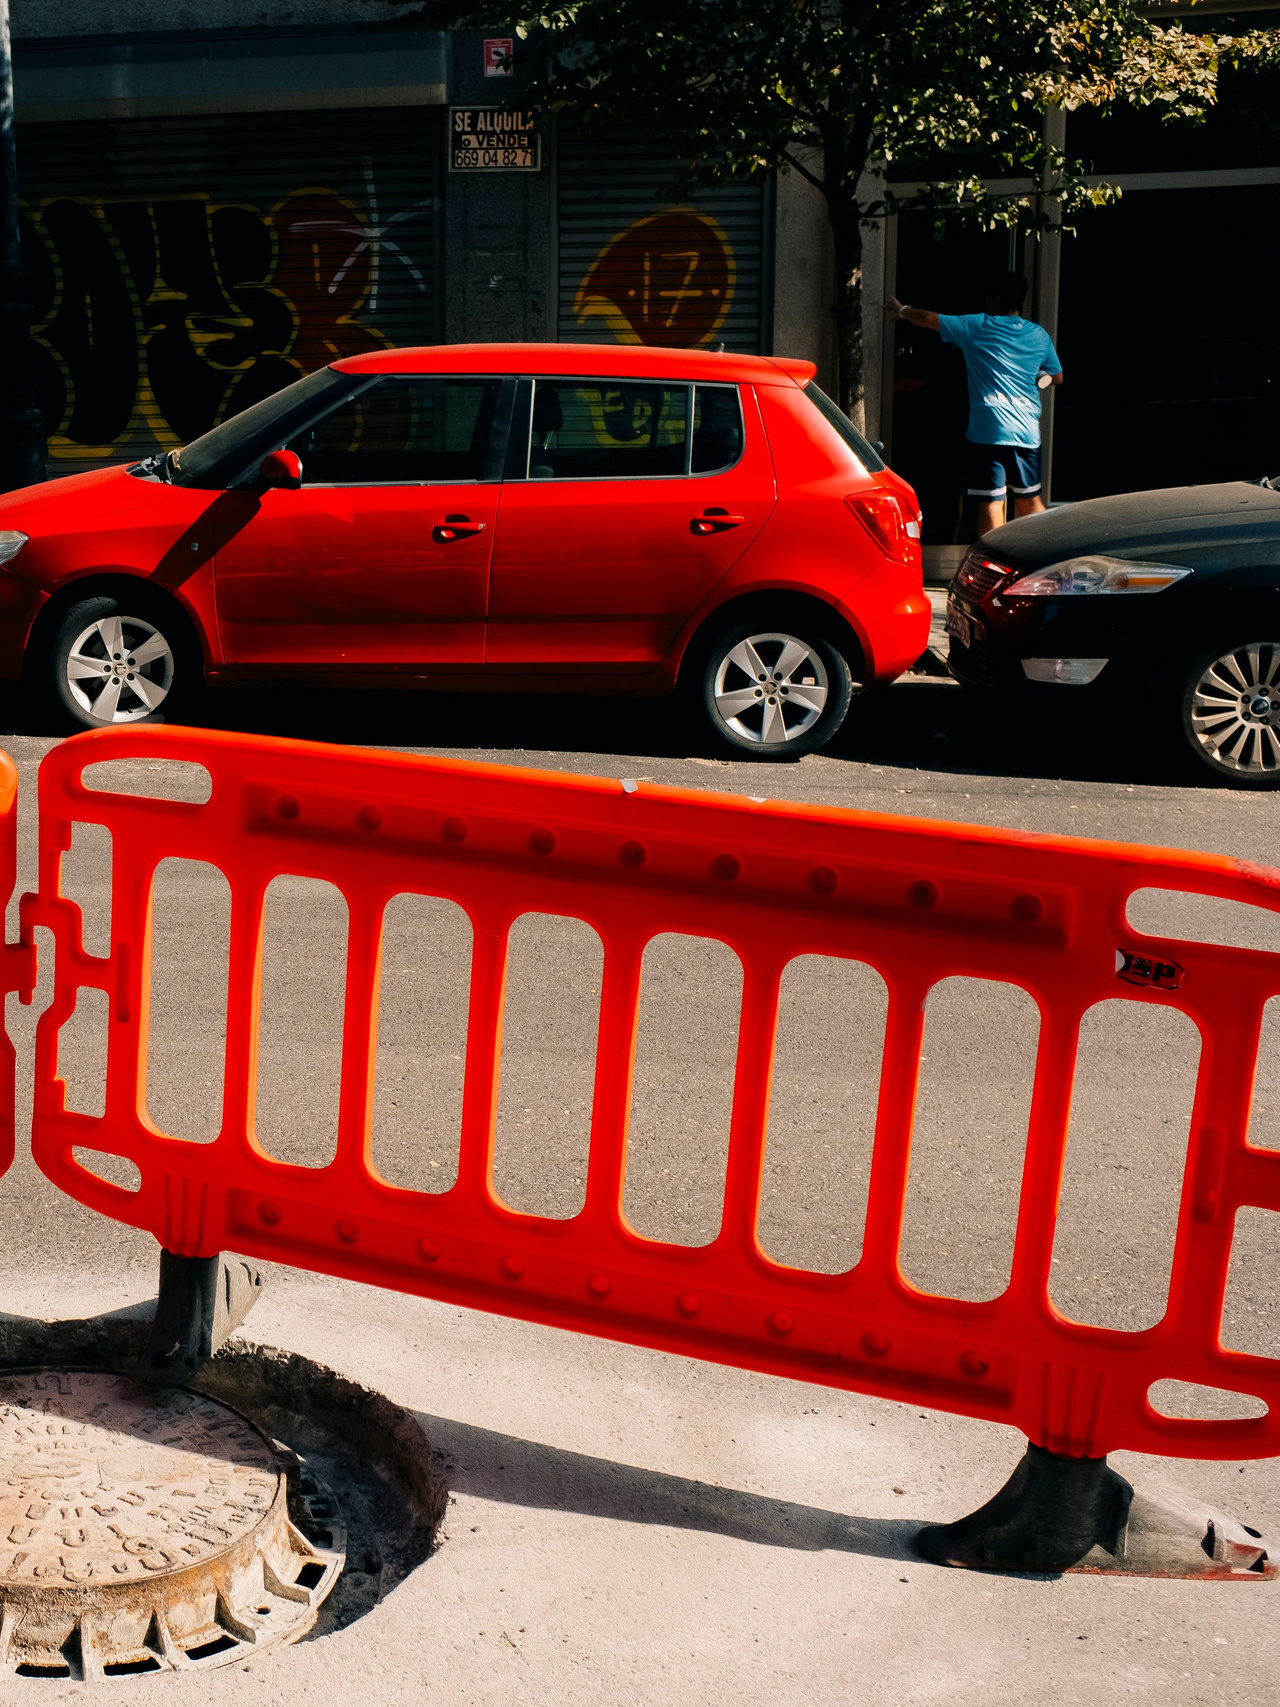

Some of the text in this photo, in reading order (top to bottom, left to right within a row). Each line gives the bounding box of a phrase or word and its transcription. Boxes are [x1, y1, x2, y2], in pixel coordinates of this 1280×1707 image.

[454, 111, 472, 132] SE
[475, 135, 528, 147] VENDE
[455, 150, 534, 166] 669 04 82 71
